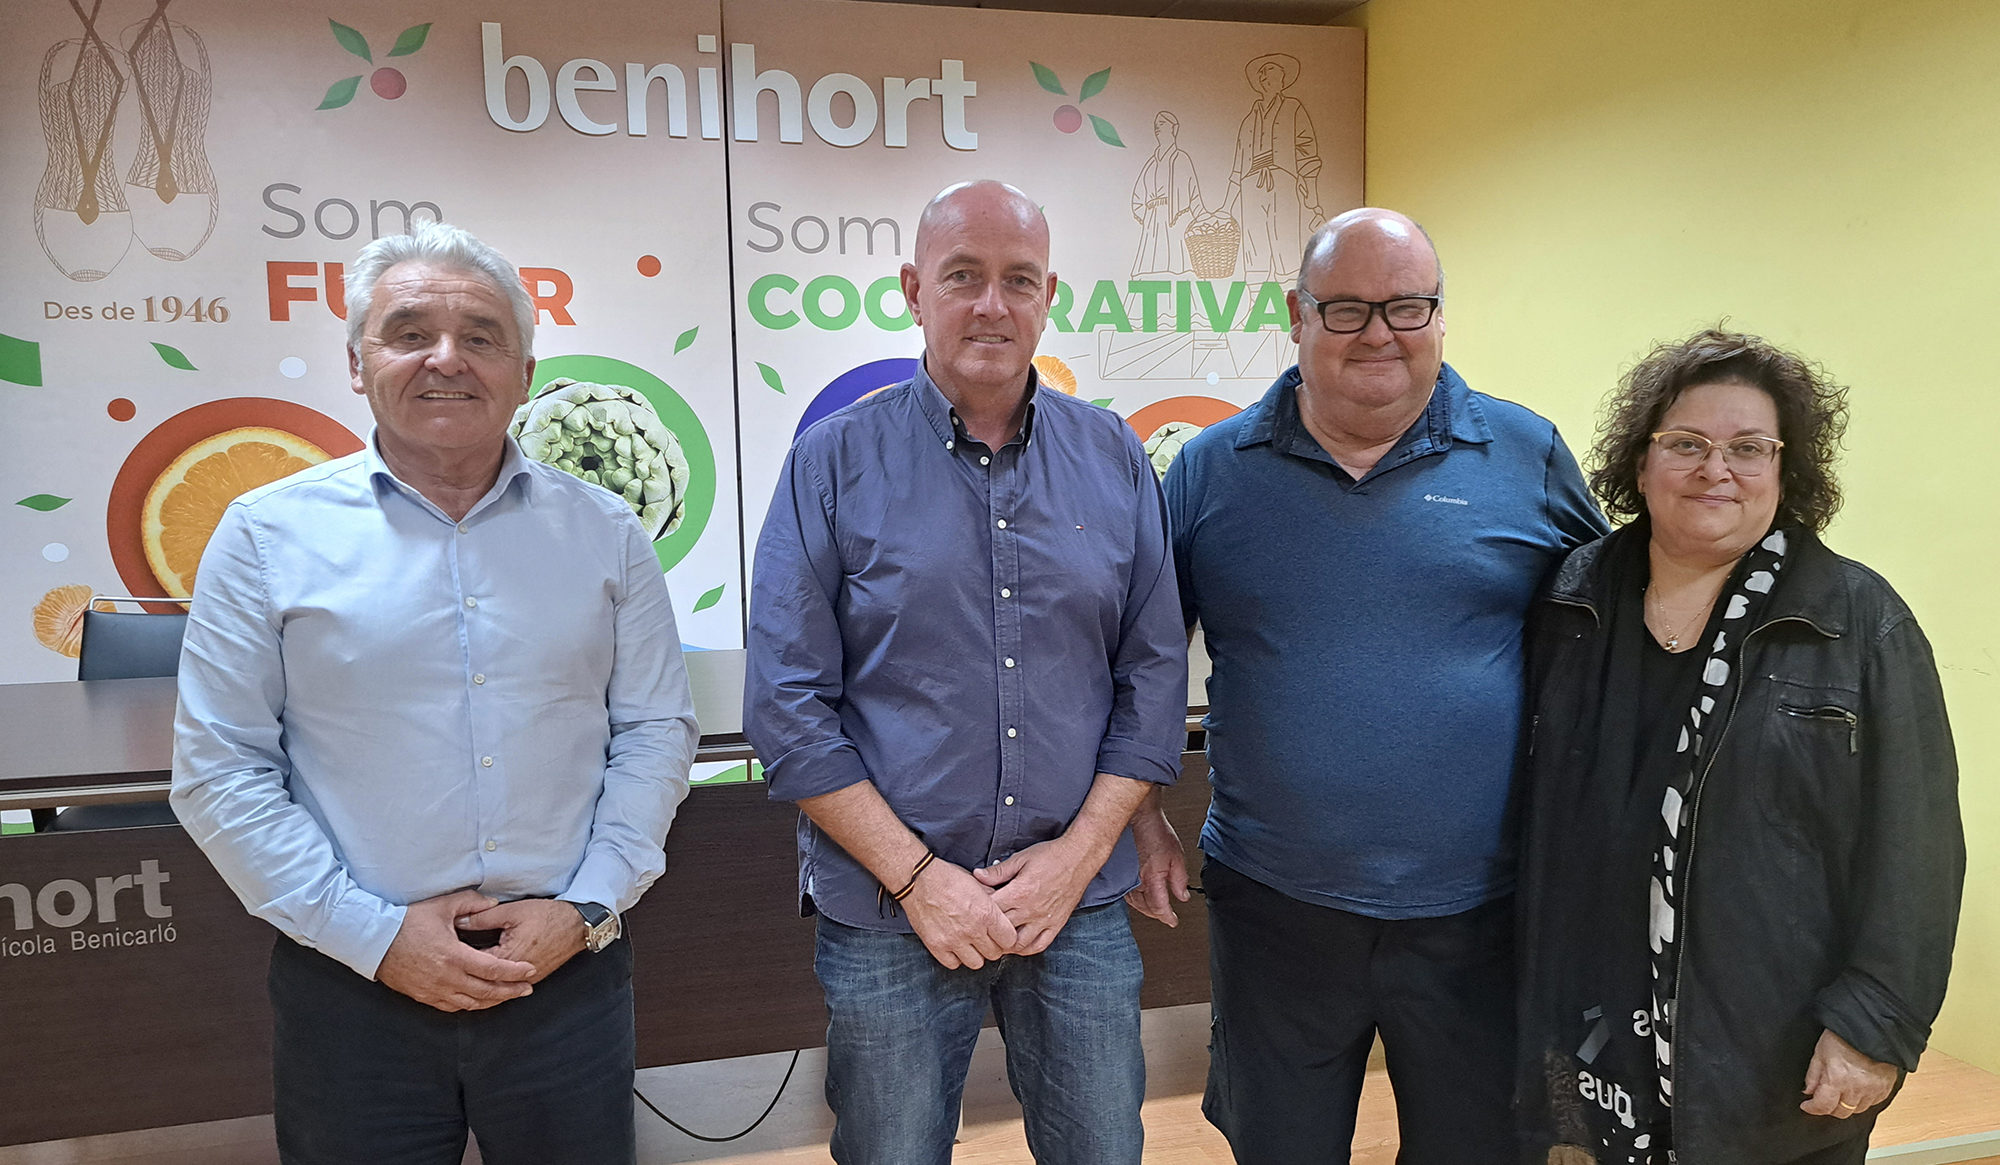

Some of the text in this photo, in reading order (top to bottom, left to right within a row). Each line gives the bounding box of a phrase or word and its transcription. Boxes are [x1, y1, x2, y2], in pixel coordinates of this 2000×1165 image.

[481, 21, 978, 151] benihort
[260, 182, 444, 241] Som
[746, 201, 901, 256] Som
[43, 295, 230, 323] Des de 1946
[1432, 494, 1468, 505] Columbia
[71, 922, 177, 951] Benicarló
